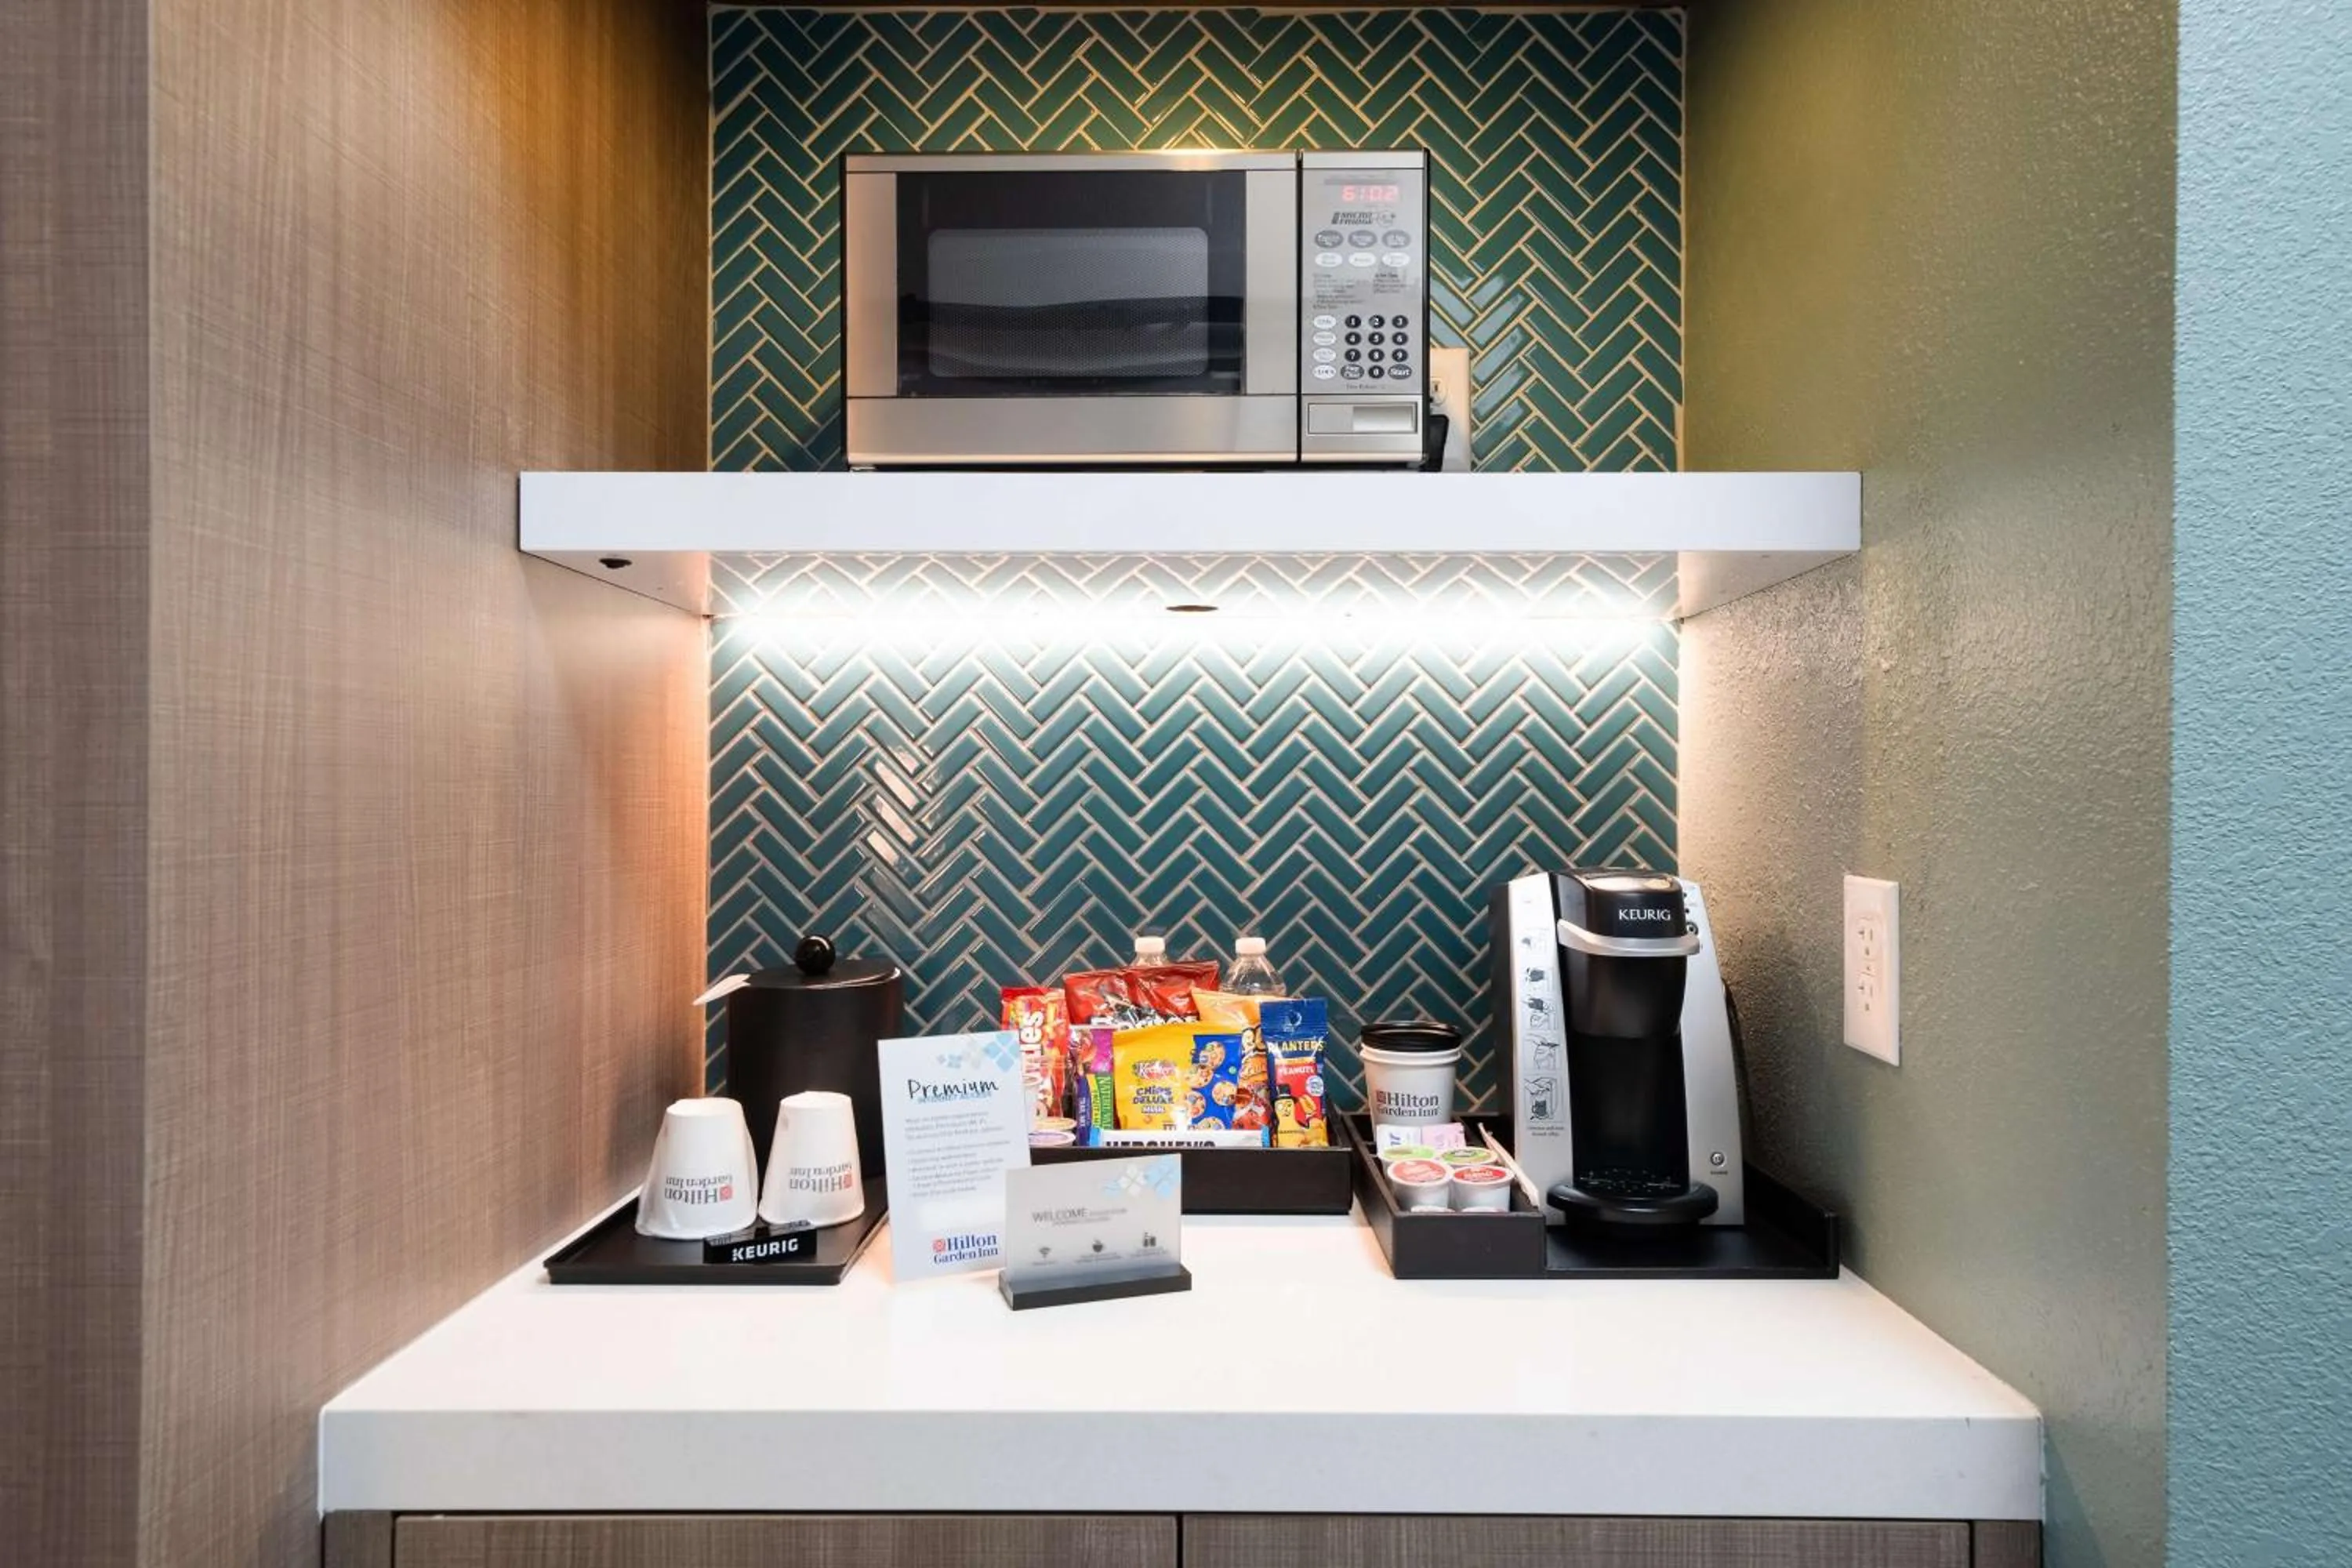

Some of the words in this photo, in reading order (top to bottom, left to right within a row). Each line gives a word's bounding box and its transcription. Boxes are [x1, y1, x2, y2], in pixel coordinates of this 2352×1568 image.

[1619, 909, 1671, 920] KEURIG
[1267, 1040, 1325, 1054] PLANTERS
[907, 1079, 999, 1099] Premium
[1385, 1091, 1439, 1107] Hilton
[789, 1175, 844, 1192] Hilton
[664, 1186, 718, 1205] Hilton
[1032, 1208, 1089, 1223] WELCOME
[731, 1238, 799, 1262] KEURIG
[947, 1233, 997, 1252] Hilton
[934, 1248, 977, 1265] Garden
[978, 1247, 998, 1258] Inn
